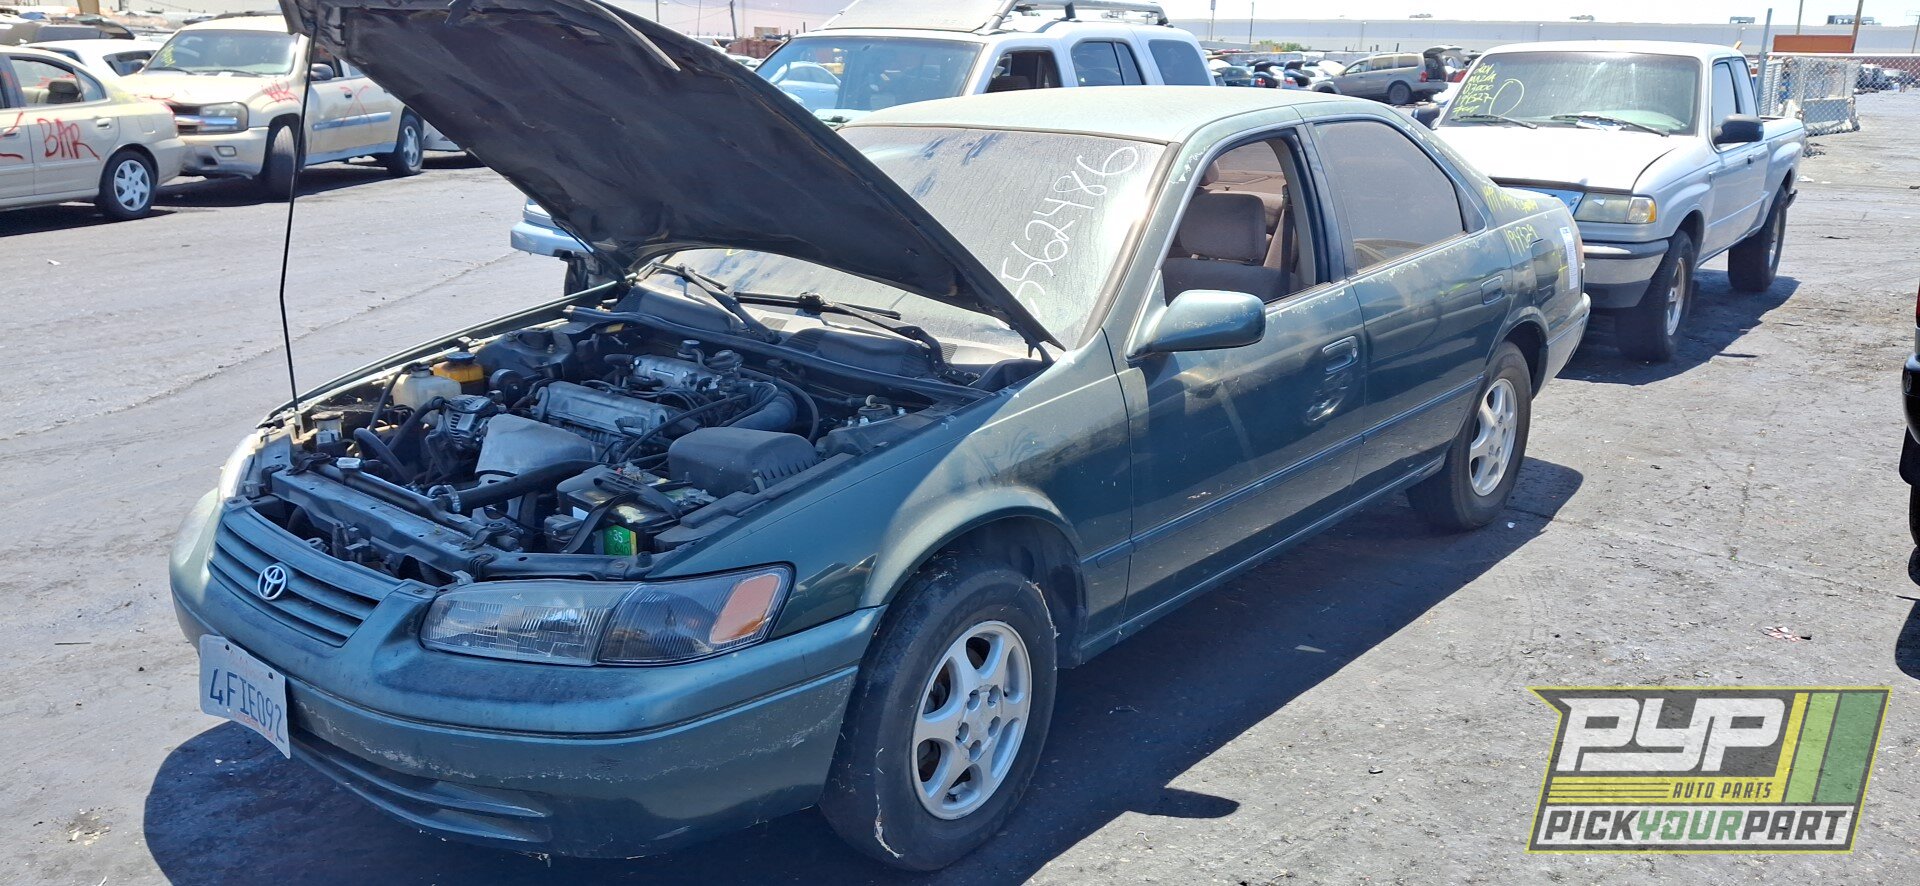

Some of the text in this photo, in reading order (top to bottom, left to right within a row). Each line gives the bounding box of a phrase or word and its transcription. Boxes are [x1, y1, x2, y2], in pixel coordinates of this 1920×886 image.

[37, 118, 101, 160] BAR
[613, 529, 624, 543] 35
[209, 668, 285, 744] 4FIE092
